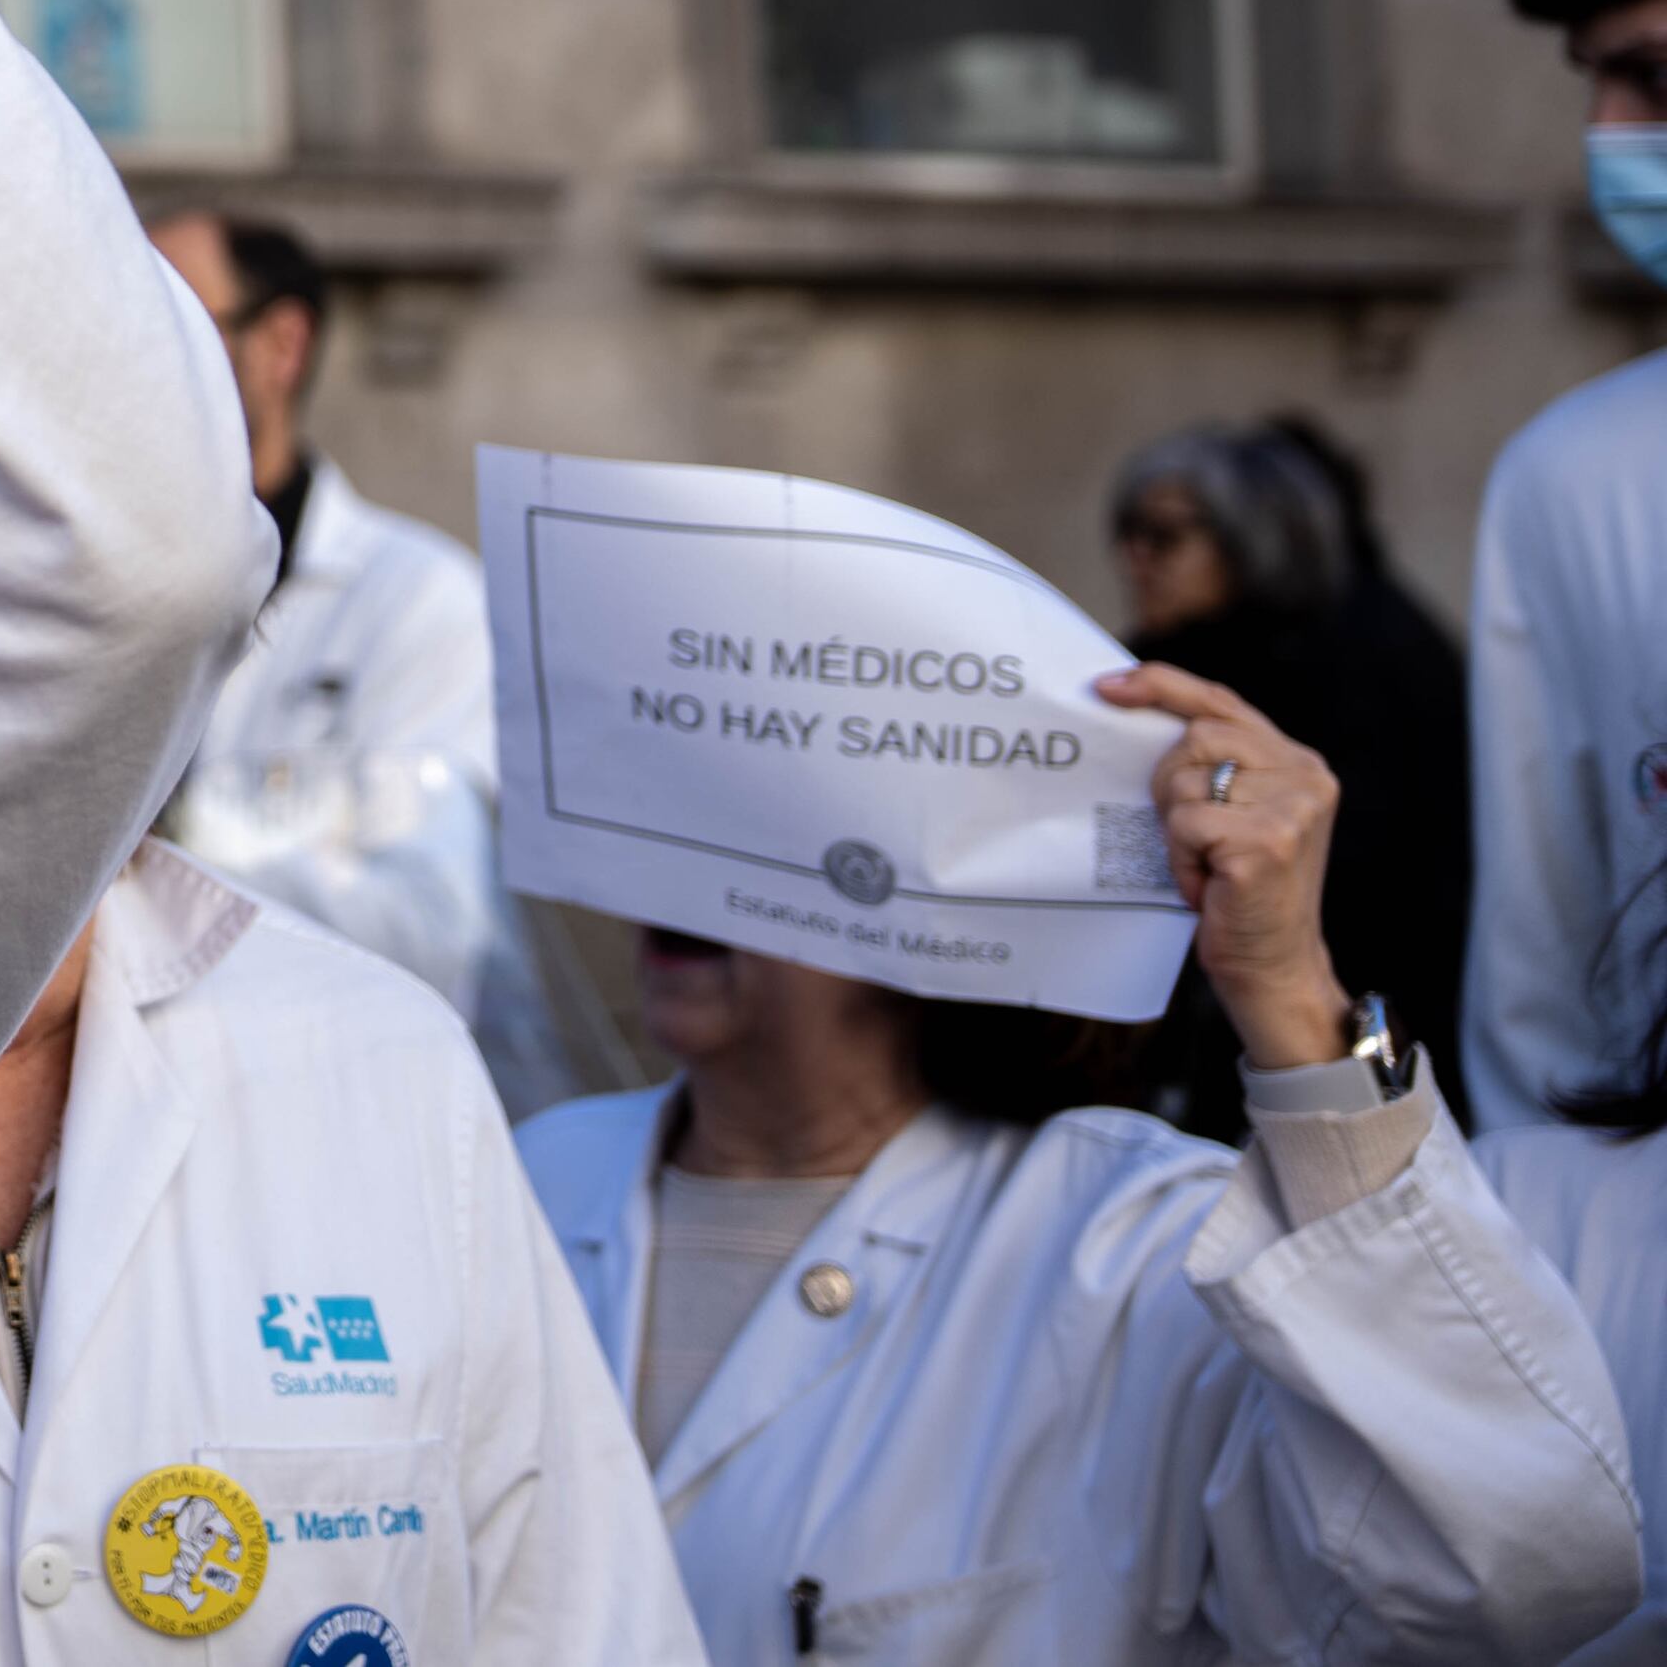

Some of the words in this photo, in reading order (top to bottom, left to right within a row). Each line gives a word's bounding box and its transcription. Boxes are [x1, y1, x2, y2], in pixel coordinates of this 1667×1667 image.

[668, 627, 753, 677] SIN
[769, 634, 1026, 698] MÉDICOS
[631, 686, 706, 734] NO
[720, 702, 822, 750] HAY
[837, 716, 1084, 772] SANIDAD
[726, 889, 841, 935] Estatuto
[845, 919, 893, 950] del
[896, 924, 1013, 966] Médico
[294, 1506, 371, 1542] Martín
